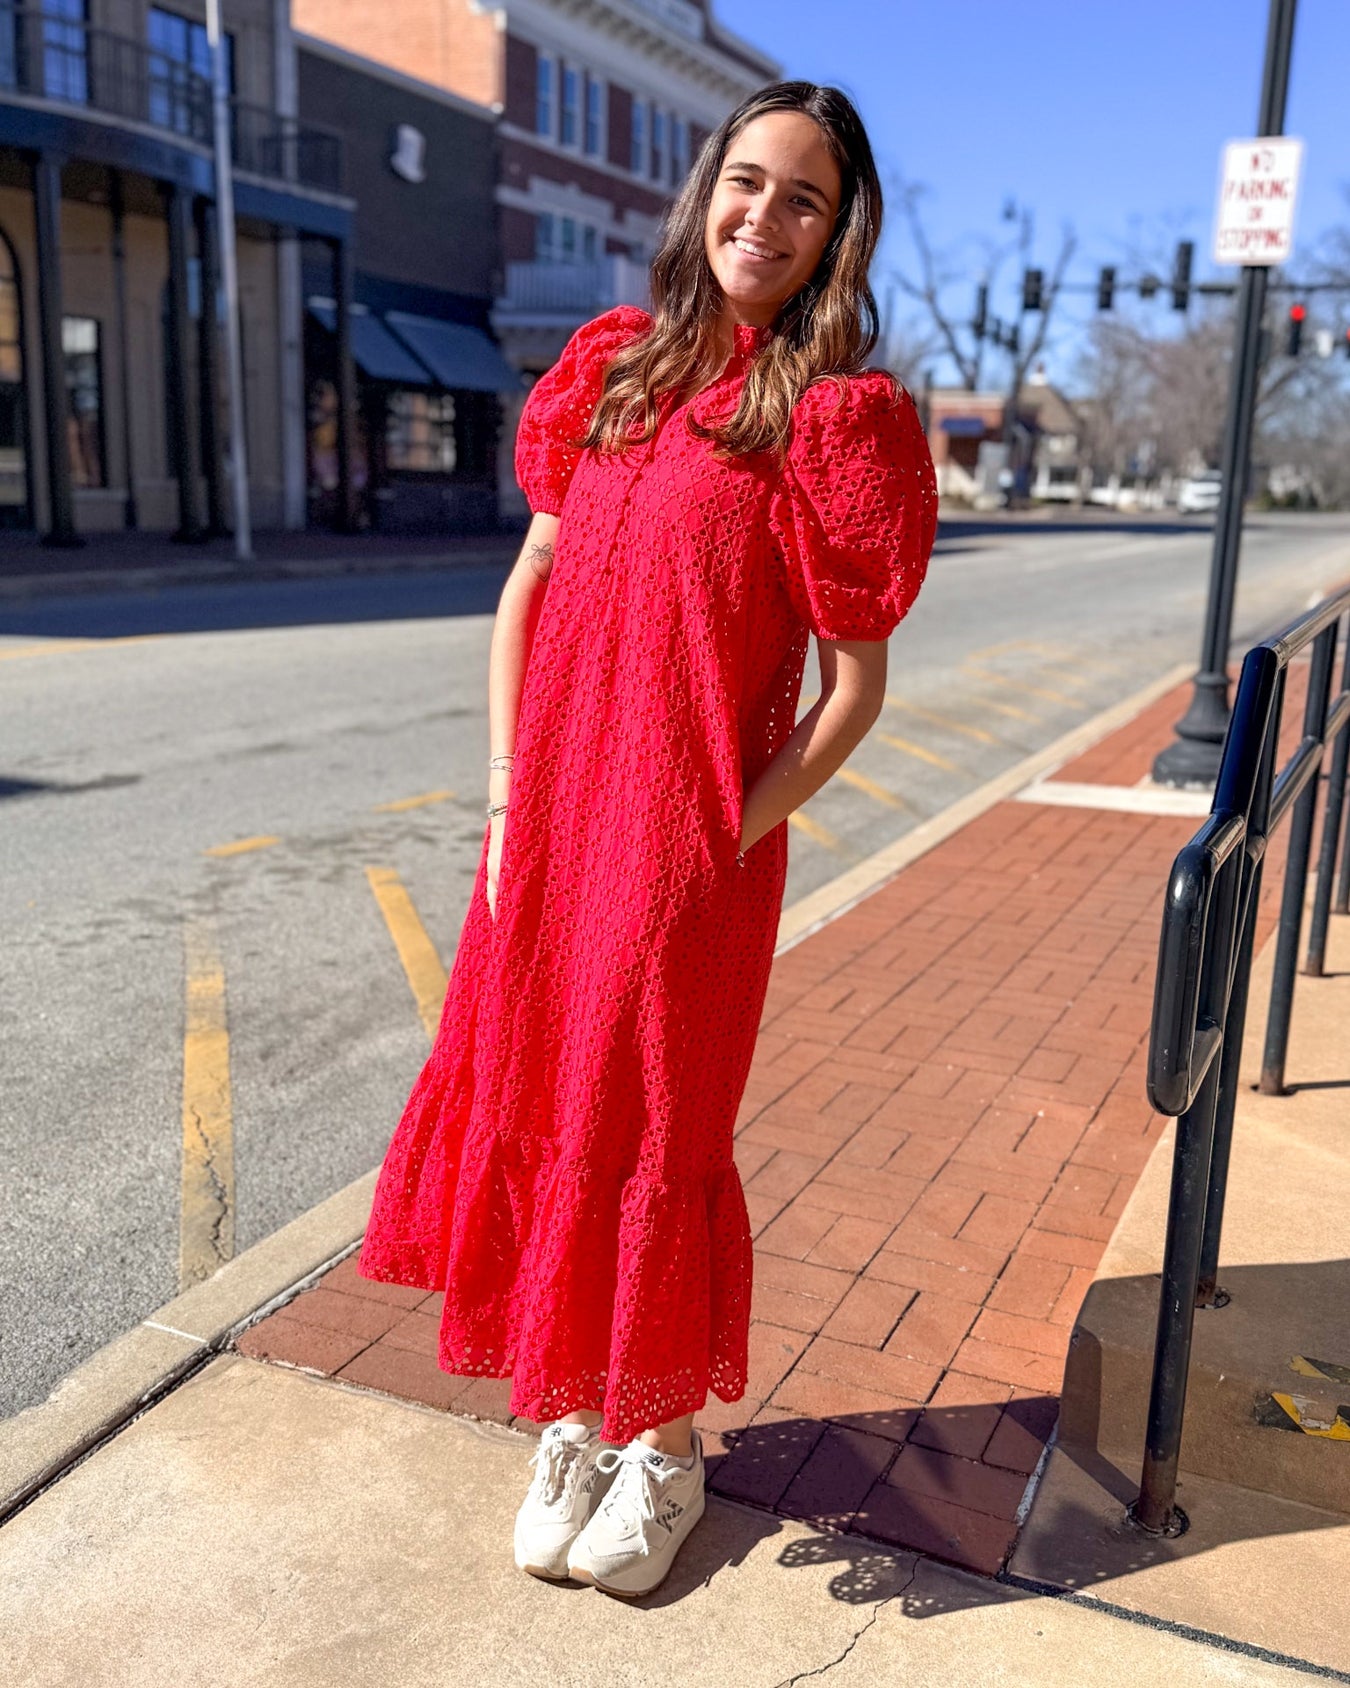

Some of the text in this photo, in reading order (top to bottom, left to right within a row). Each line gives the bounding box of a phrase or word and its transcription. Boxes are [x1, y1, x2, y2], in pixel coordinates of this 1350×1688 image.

[1250, 150, 1275, 173] NO
[1224, 178, 1291, 201] PARKING
[1219, 226, 1289, 250] STOPPING
